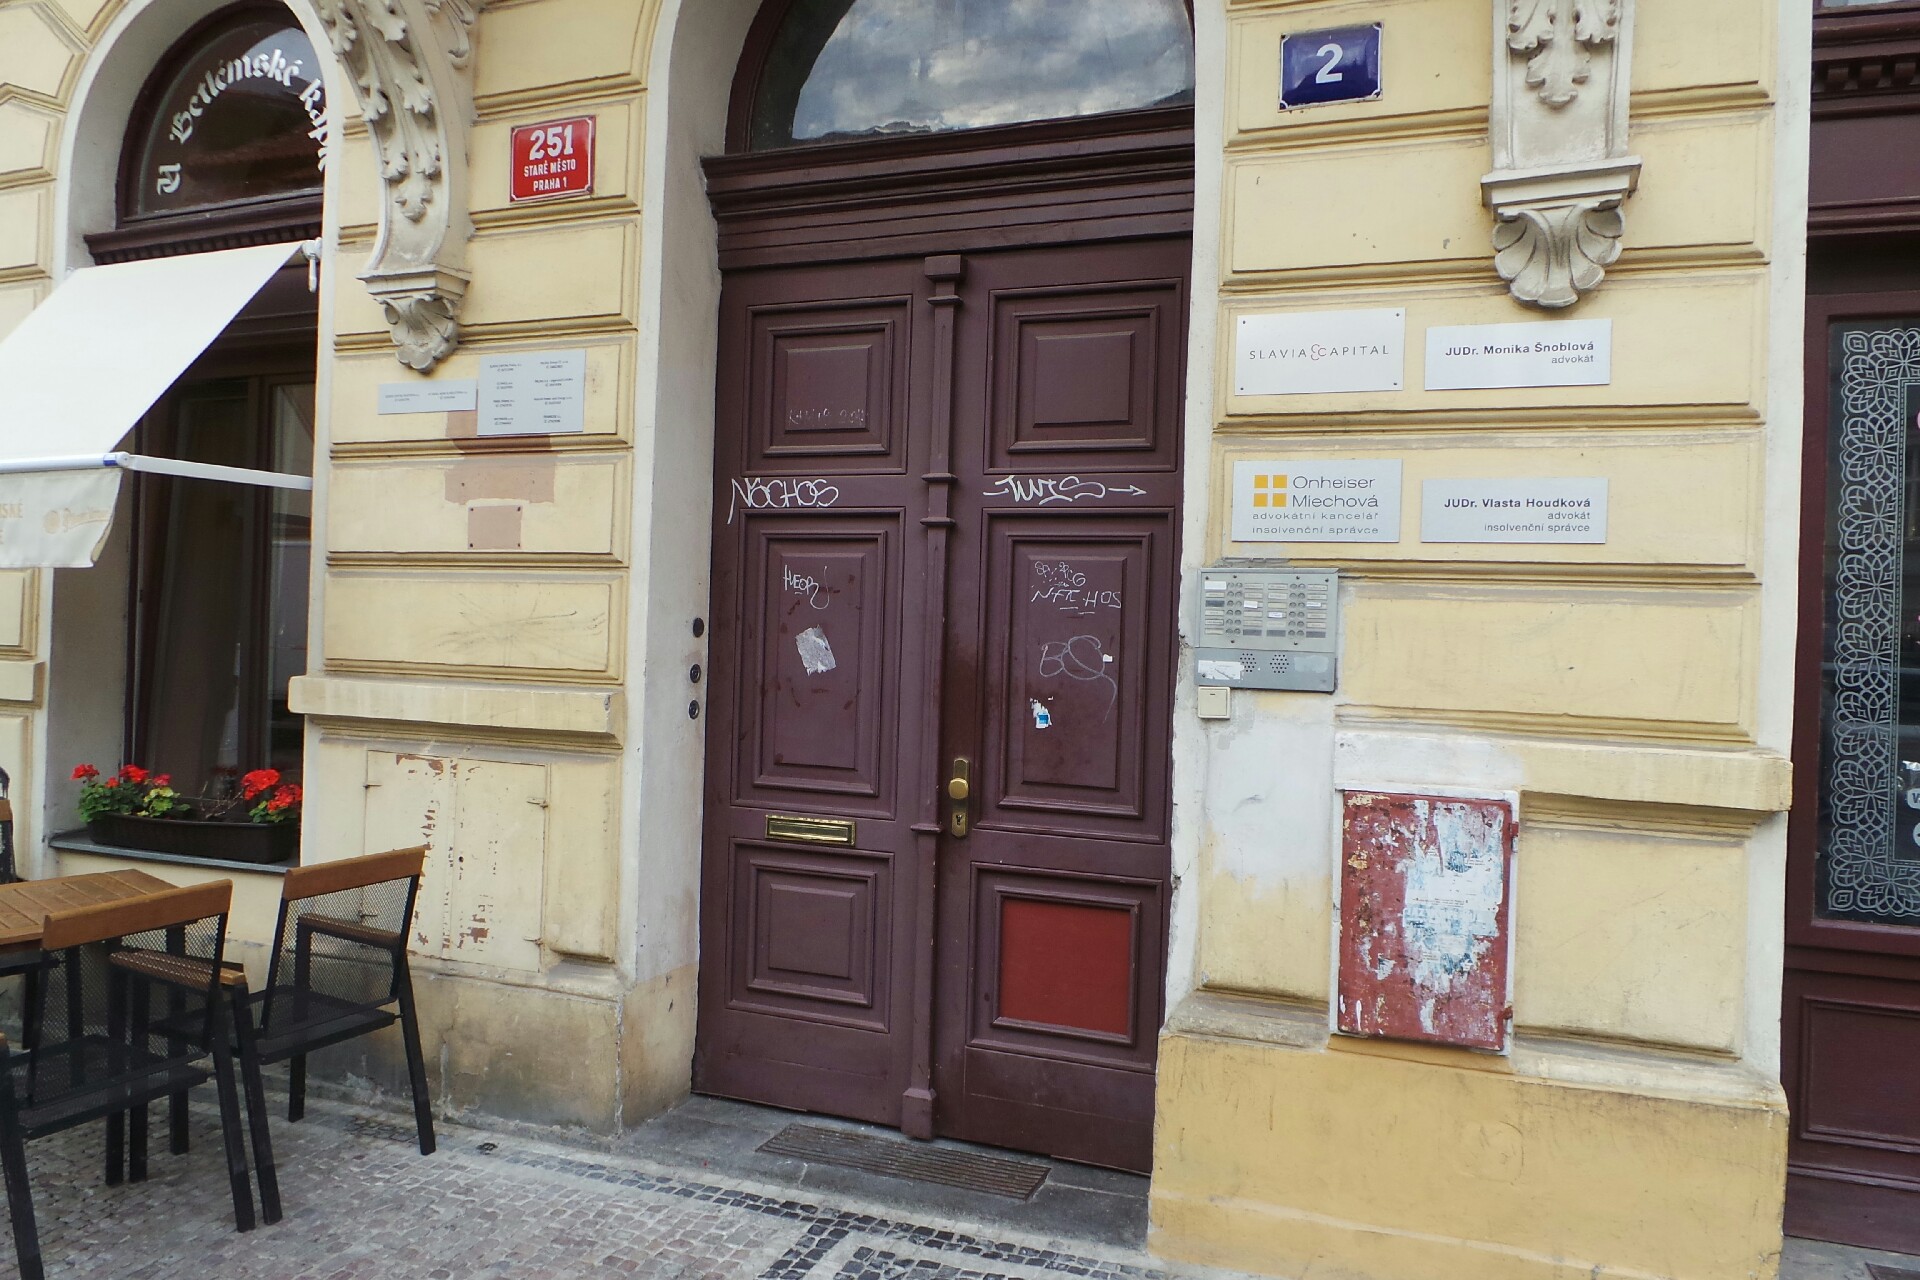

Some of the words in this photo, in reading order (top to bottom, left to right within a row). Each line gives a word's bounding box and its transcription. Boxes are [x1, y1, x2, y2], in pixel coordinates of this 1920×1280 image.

[1315, 43, 1343, 84] 2
[528, 124, 574, 161] 251
[523, 160, 549, 177] STARÉ
[549, 158, 577, 174] MĚSTO
[533, 178, 561, 192] PRAHA
[562, 176, 568, 188] 1
[1249, 347, 1307, 360] SLAVIA
[1445, 346, 1479, 356] JUDr.
[1483, 344, 1530, 355] Monika
[1534, 341, 1594, 353] Šnoblová
[1551, 354, 1594, 364] advokát
[1292, 475, 1376, 489] Onheiser
[1292, 494, 1379, 508] Miechová
[1444, 498, 1478, 508] JUDr.
[1482, 498, 1521, 508] Vlasta
[1525, 497, 1591, 508] Houdková
[1252, 511, 1316, 520] advokátní
[1321, 511, 1379, 520] kancelář
[1547, 511, 1591, 520] advokát
[1252, 525, 1324, 534] insolvenční
[1328, 526, 1379, 536] správce
[1484, 523, 1544, 532] insolvenční
[1547, 523, 1590, 533] správce
